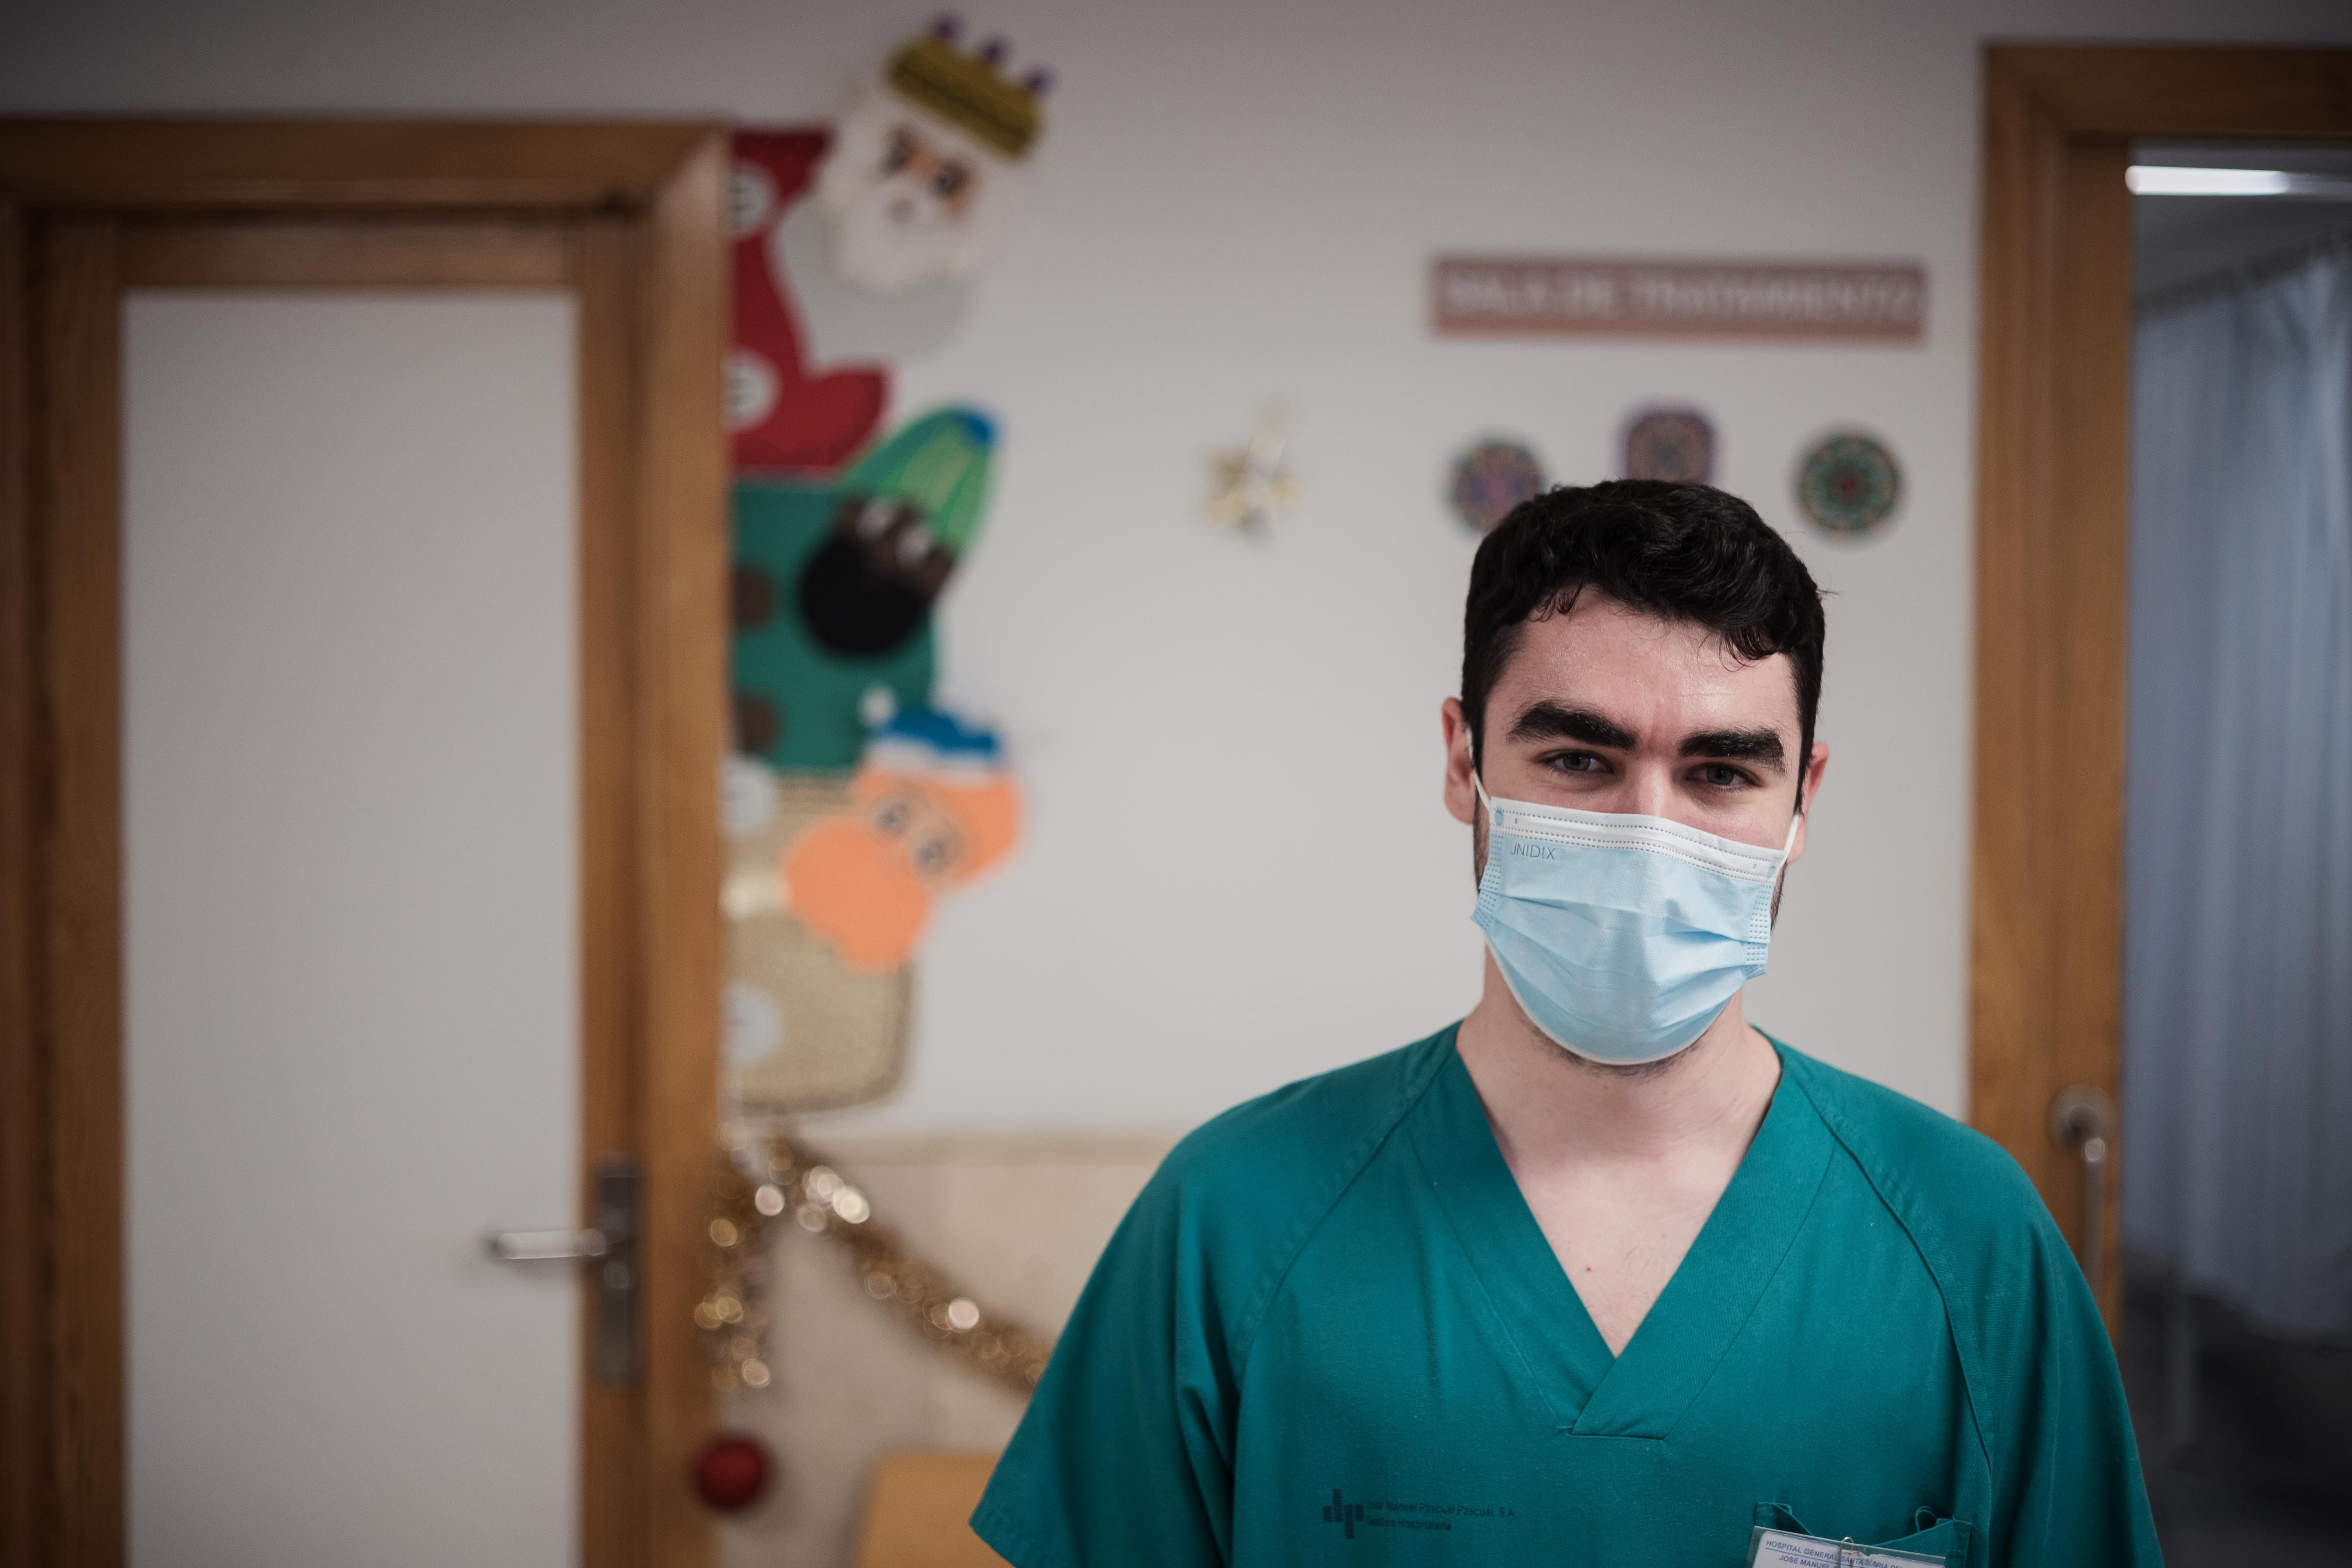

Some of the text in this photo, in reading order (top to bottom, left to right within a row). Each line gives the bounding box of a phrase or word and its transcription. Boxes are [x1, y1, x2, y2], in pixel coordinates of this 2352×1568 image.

[1766, 1540, 1802, 1553] HOSPITAL
[1804, 1548, 1839, 1561] GENERAL
[1779, 1555, 1798, 1564] JOSE
